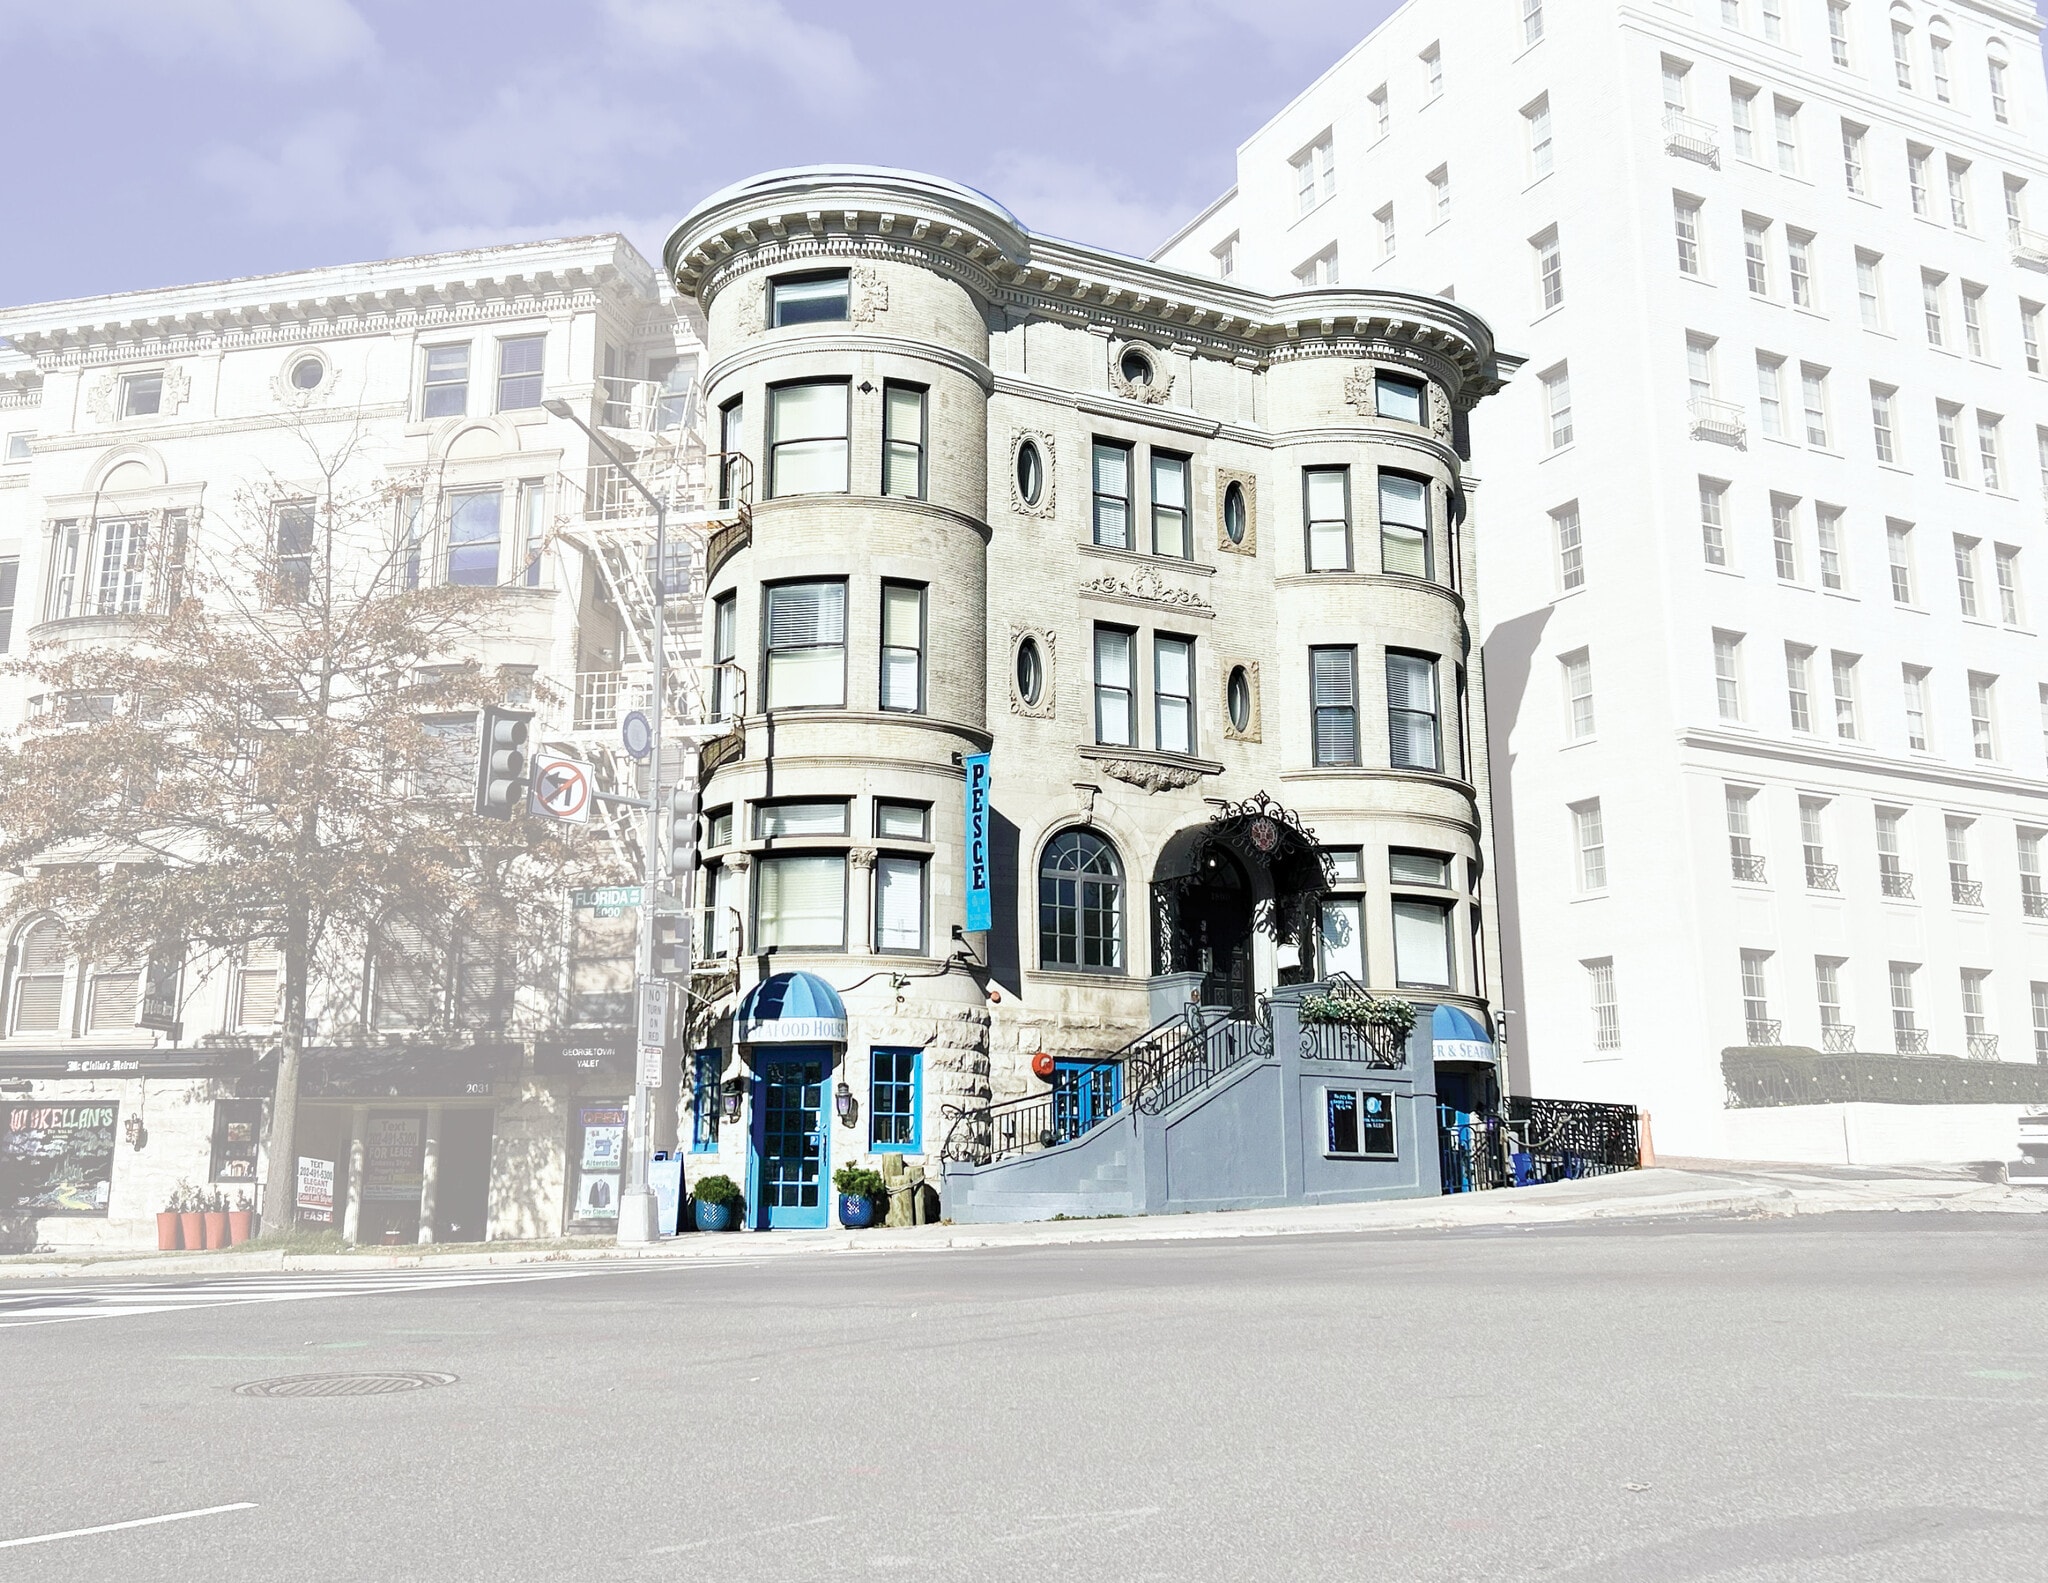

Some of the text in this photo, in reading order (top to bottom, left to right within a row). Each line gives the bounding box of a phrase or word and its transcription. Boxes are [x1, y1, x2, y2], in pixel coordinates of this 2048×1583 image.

[972, 763, 986, 890] PESCE
[575, 890, 628, 906] FLORIDA
[649, 989, 661, 1002] NO
[647, 1004, 662, 1015] TURN
[649, 1018, 659, 1028] ON
[814, 1020, 846, 1038] HOUSE
[648, 1031, 660, 1042] RED
[562, 1048, 616, 1057] GEORGETOWN
[1448, 1044, 1457, 1057] &
[577, 1059, 600, 1068] VALET
[466, 1083, 489, 1094] 2031
[583, 1112, 623, 1124] OPEN
[381, 1120, 406, 1131] Text
[369, 1146, 414, 1159] FOR LEASE
[310, 1160, 324, 1168] TEXT
[303, 1177, 329, 1187] ELEGANT
[304, 1185, 328, 1196] OFFICES
